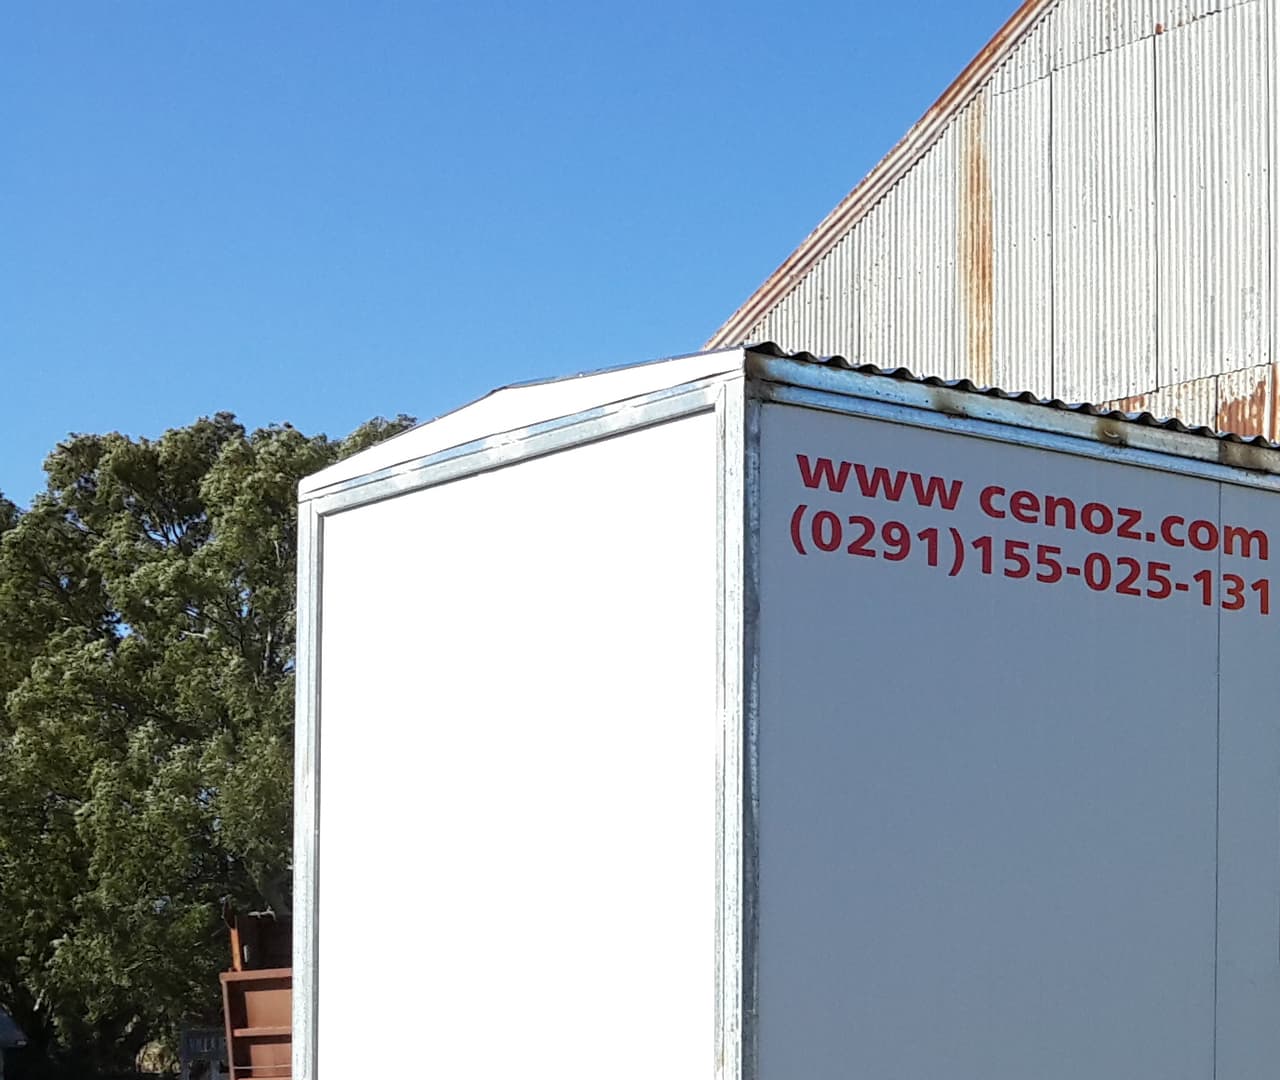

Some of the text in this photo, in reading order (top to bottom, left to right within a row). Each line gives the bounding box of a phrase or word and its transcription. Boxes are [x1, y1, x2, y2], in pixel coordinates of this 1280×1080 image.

[789, 504, 1271, 616] (0291)155-025-131
[796, 453, 1269, 561] www cenoz.com
